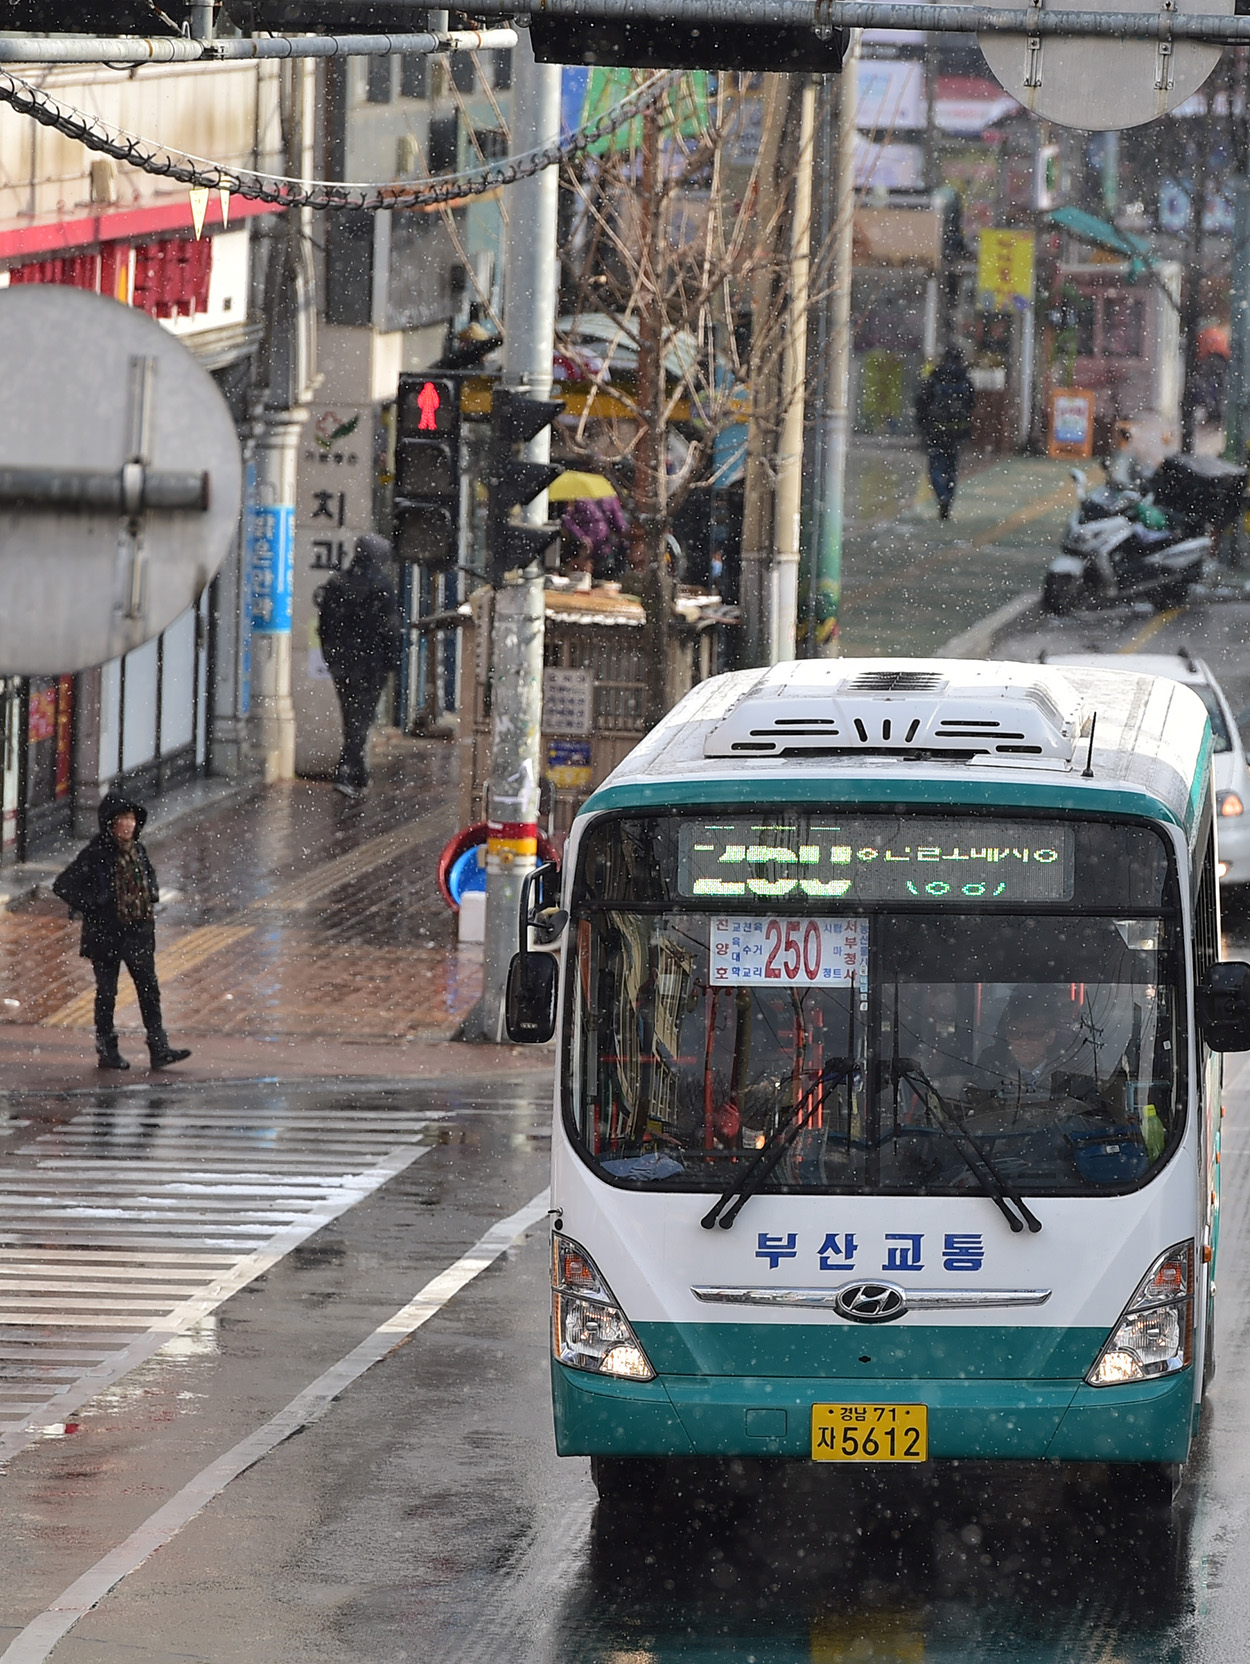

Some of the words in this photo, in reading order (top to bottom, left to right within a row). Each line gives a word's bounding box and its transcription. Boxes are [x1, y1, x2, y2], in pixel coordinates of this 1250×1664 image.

[715, 919, 730, 979] 진양호
[732, 922, 741, 977] 교육대학
[753, 922, 763, 977] 육거리
[765, 919, 822, 981] 250
[844, 920, 858, 981] 서부청사
[755, 1232, 985, 1272] 부산교통
[840, 1407, 867, 1422] 경남
[873, 1407, 896, 1422] 71
